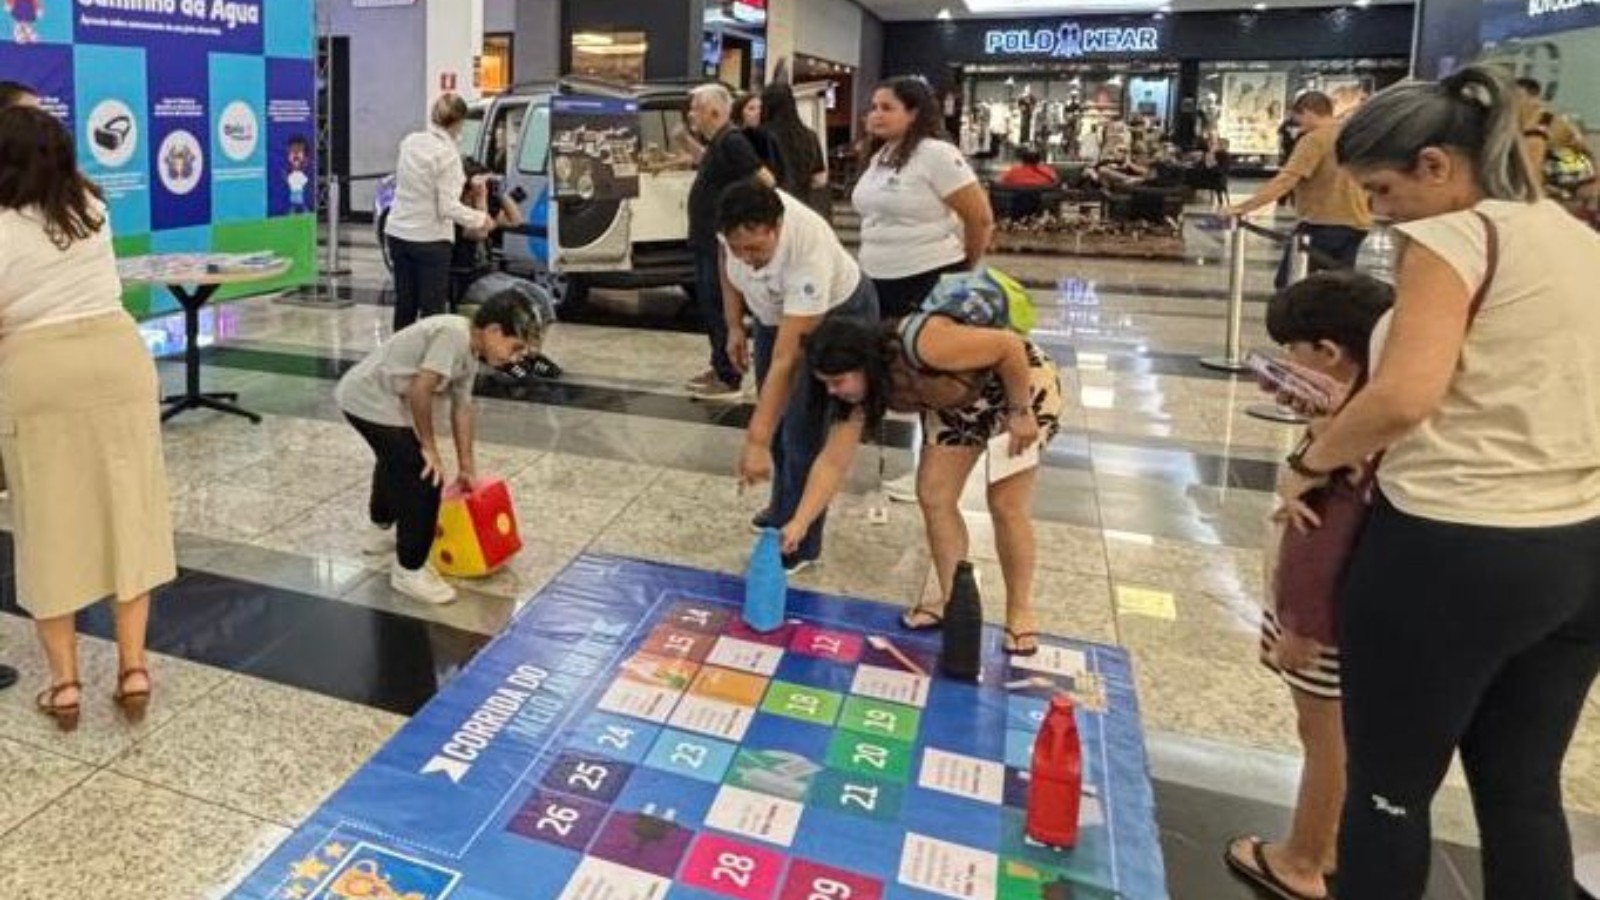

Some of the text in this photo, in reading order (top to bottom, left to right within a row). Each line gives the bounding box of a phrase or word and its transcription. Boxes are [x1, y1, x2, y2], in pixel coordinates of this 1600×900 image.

[985, 27, 1158, 53] POLO WEAR
[664, 634, 695, 653] 15
[811, 634, 841, 654] 12
[442, 663, 549, 762] CORRIDA DO
[787, 692, 820, 715] 18
[863, 709, 898, 733] 19
[598, 725, 635, 750] 24
[671, 742, 708, 769] 23
[853, 742, 889, 770] 20
[568, 762, 609, 791] 25
[840, 784, 879, 812] 21
[537, 804, 579, 836] 26
[712, 852, 756, 888] 28
